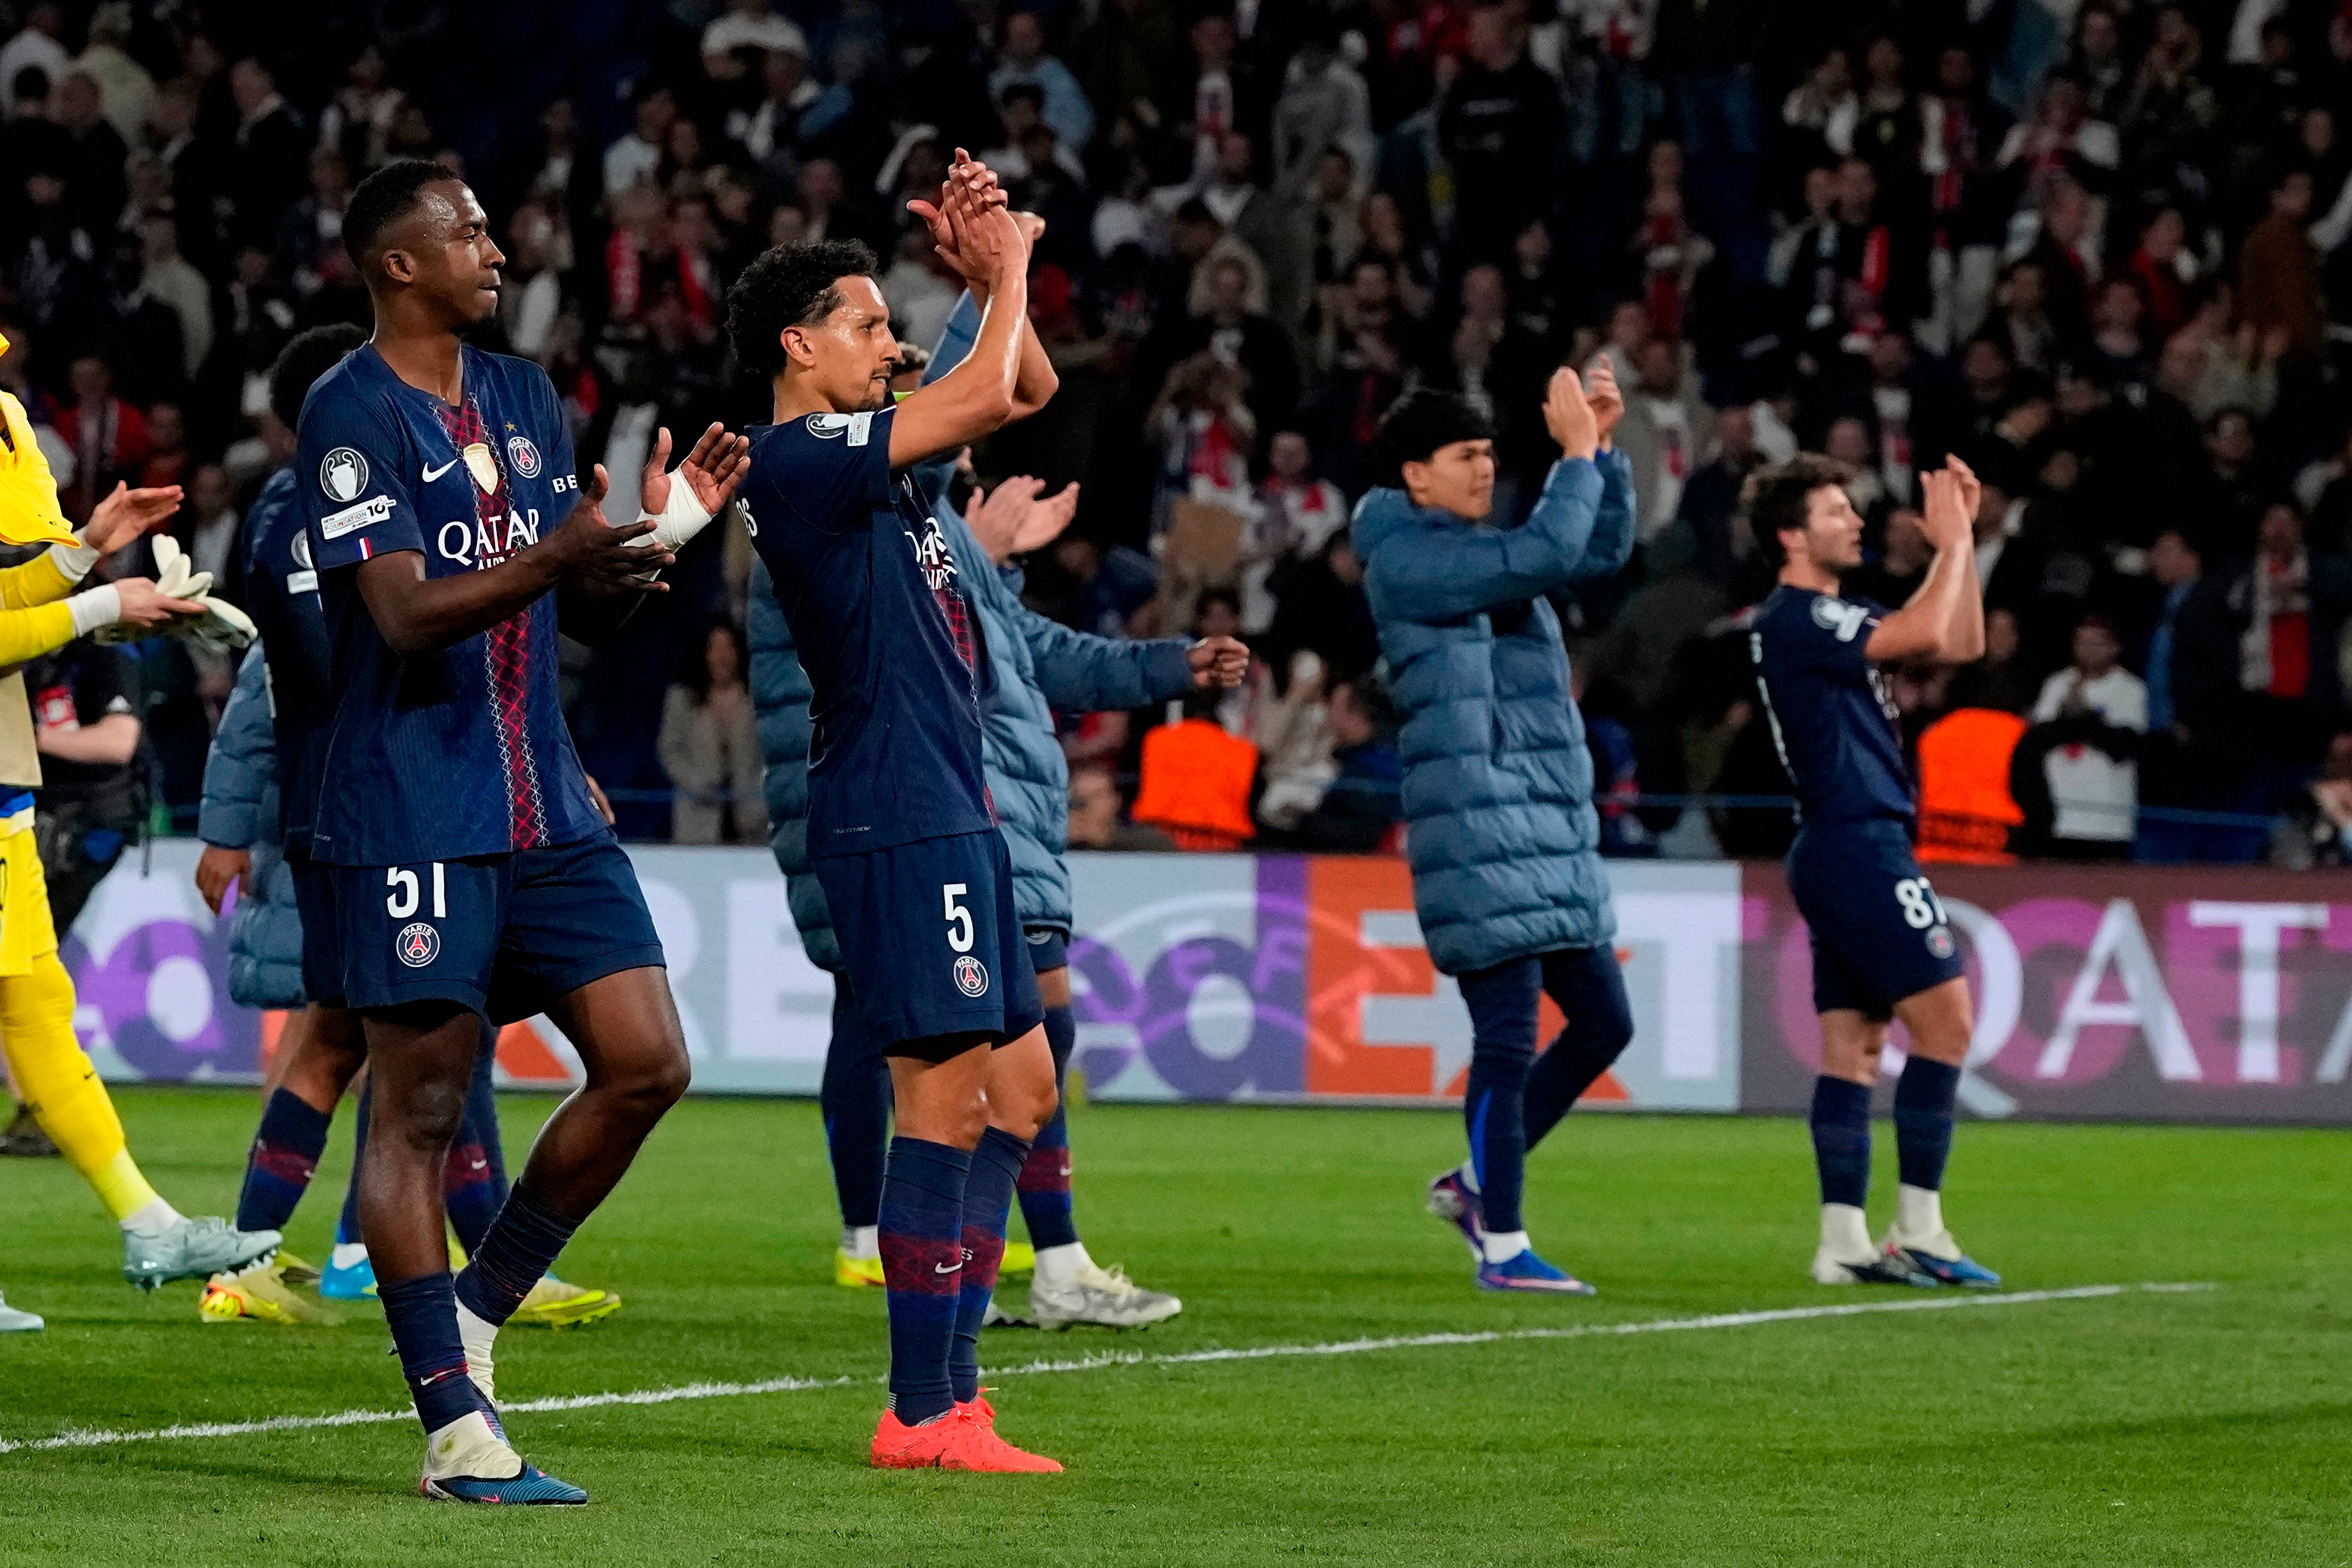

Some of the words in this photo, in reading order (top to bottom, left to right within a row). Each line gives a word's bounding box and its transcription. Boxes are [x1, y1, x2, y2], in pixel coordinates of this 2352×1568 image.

[509, 439, 530, 450] PARIS
[325, 511, 367, 531] FOUNDATION
[438, 508, 539, 567] QATAR
[386, 862, 446, 918] 51
[943, 882, 974, 952] 5
[403, 924, 433, 937] PARIS
[957, 958, 979, 969] PARIS
